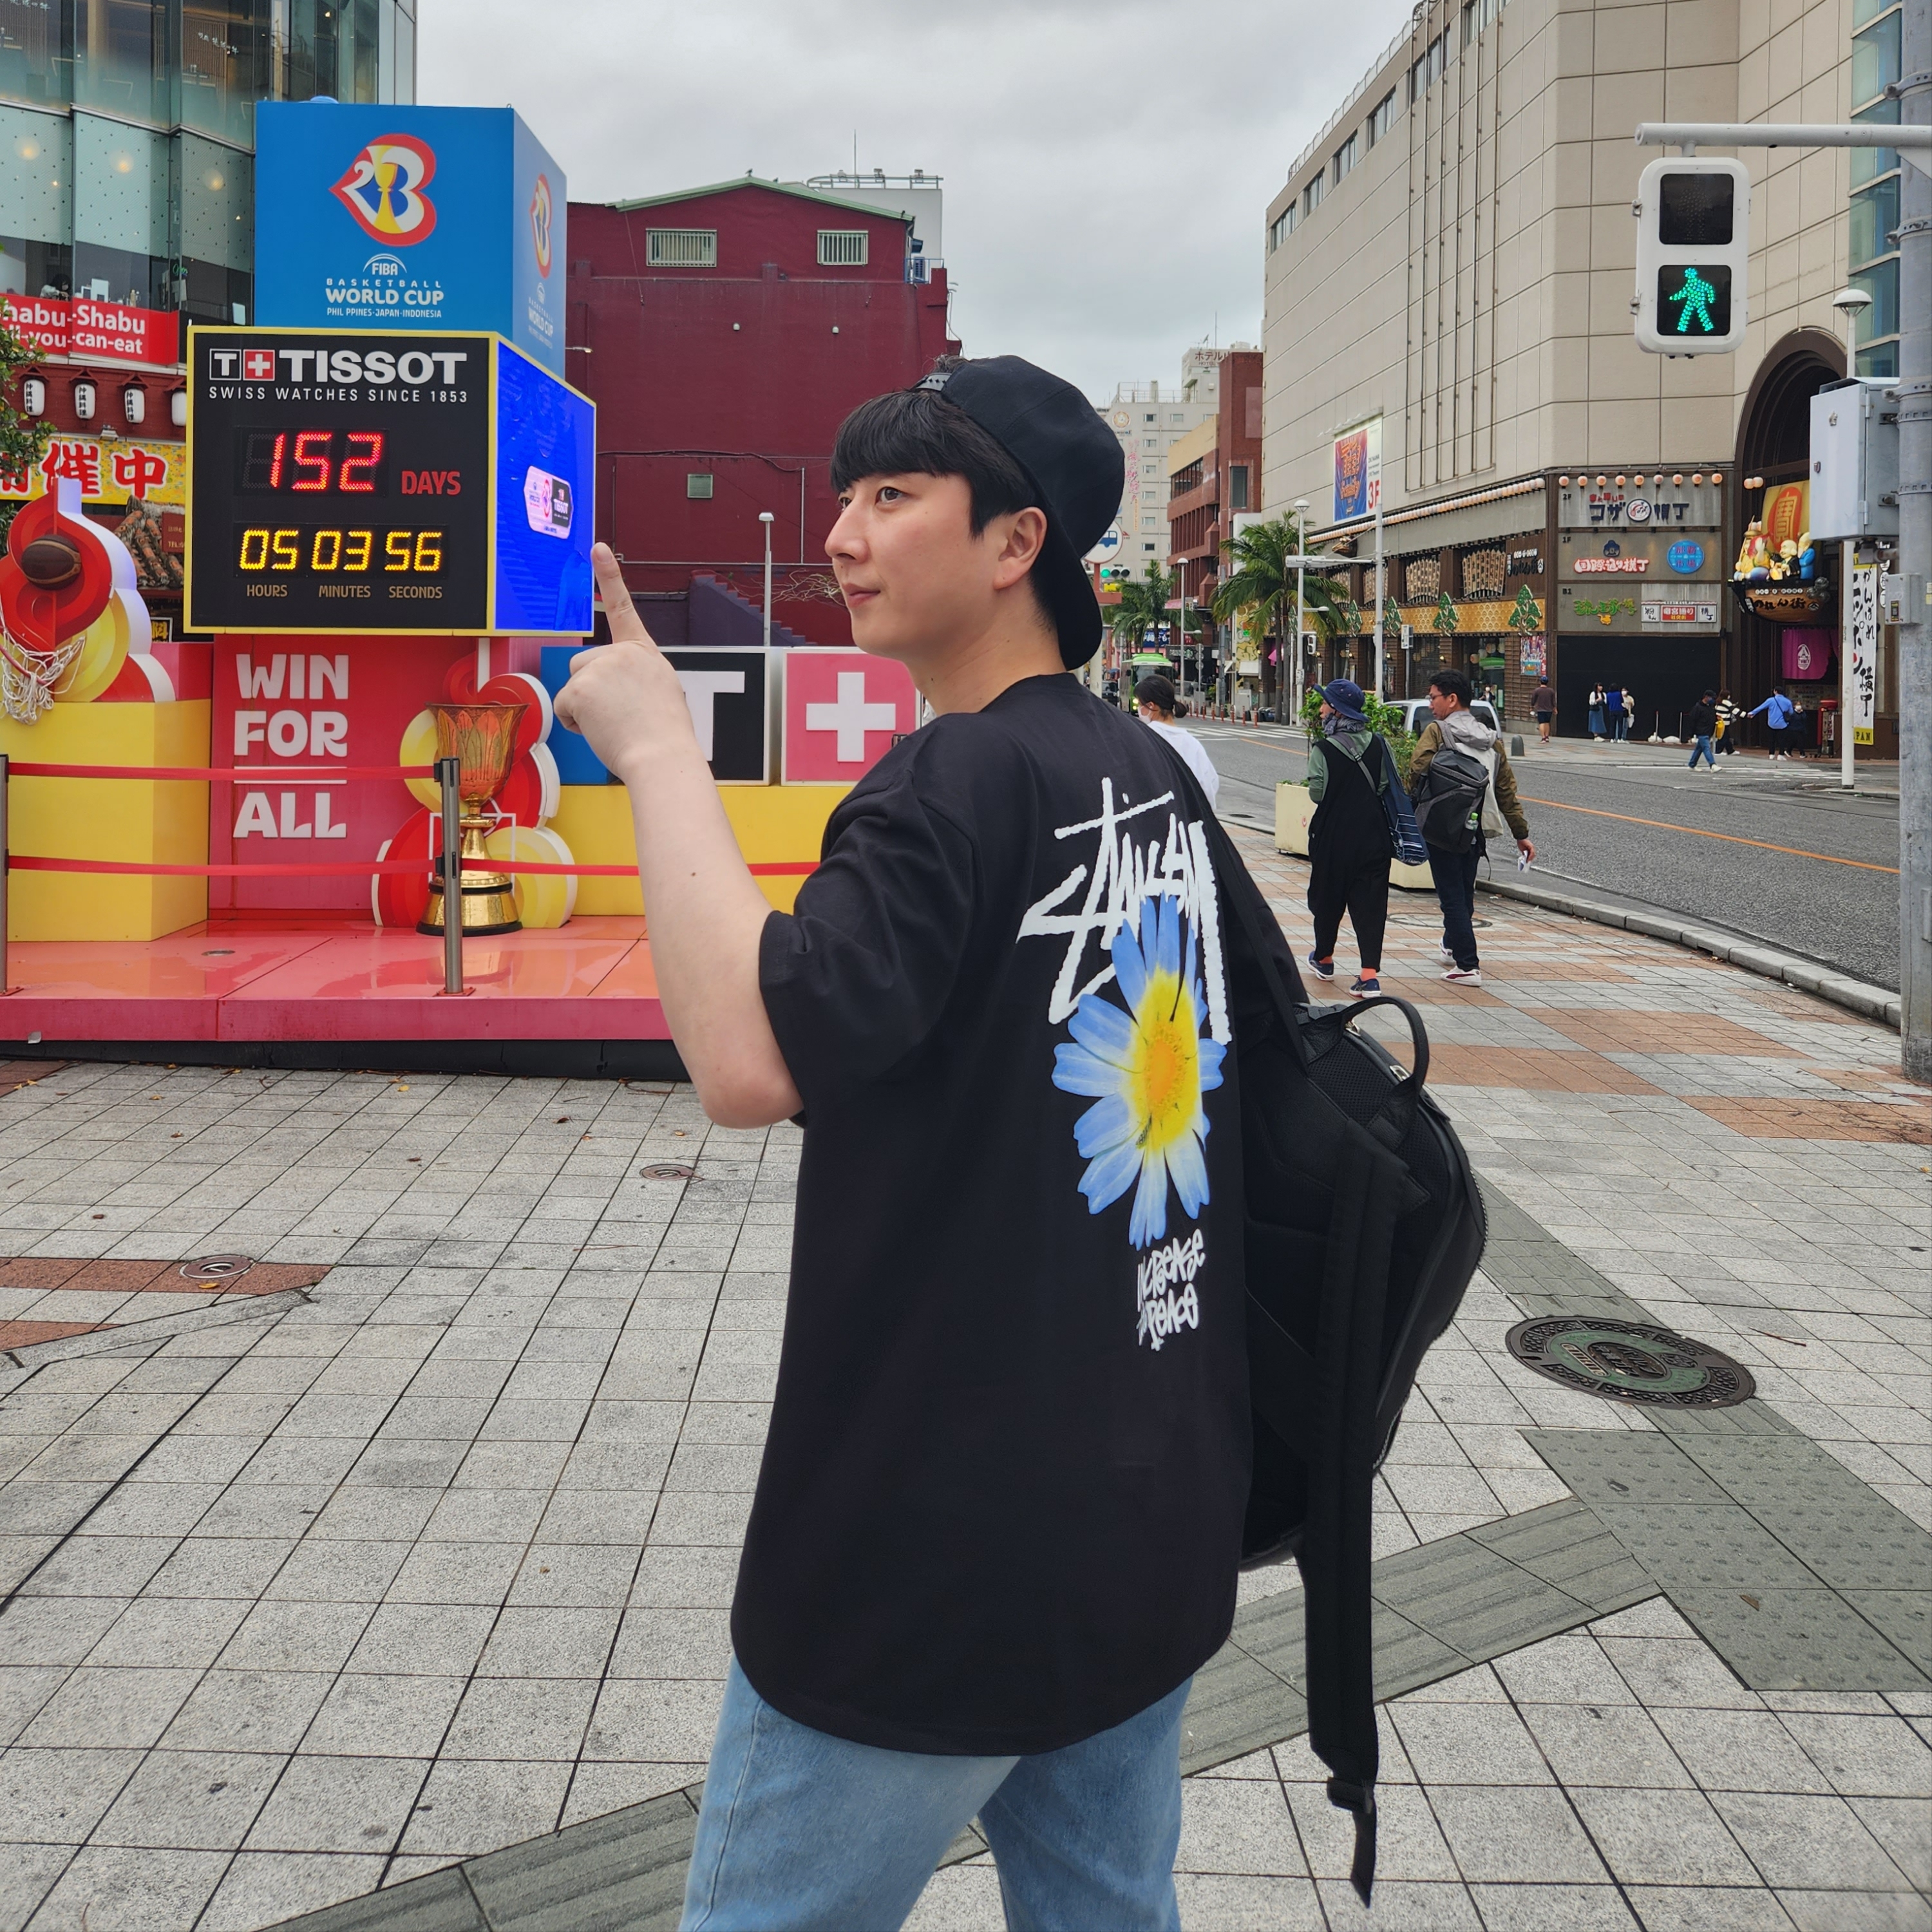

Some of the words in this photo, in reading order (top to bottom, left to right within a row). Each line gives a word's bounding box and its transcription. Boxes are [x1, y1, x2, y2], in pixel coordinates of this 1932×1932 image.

[372, 262, 398, 276] FIBA
[327, 278, 441, 289] BASKETBALL
[325, 288, 399, 305] WORLD
[404, 290, 444, 306] CUP
[279, 350, 468, 385] TISSOT
[209, 386, 266, 399] SWISS
[276, 388, 359, 401] WATCHES
[368, 390, 421, 402] SINCE
[430, 390, 468, 403] 1853
[270, 432, 383, 491] 152
[401, 471, 461, 495] DAYS
[1368, 480, 1379, 509] 3F
[1589, 502, 1627, 522] コザ
[239, 529, 299, 571] 05
[311, 530, 372, 571] 03
[384, 531, 442, 572] 56
[1574, 558, 1649, 573] 国際通り横丁
[247, 585, 288, 597] HOURS
[319, 585, 371, 598] MINUTES
[389, 586, 443, 599] SECONDS
[235, 654, 349, 700] WIN
[234, 710, 348, 757] FOR
[232, 791, 348, 839] ALL
